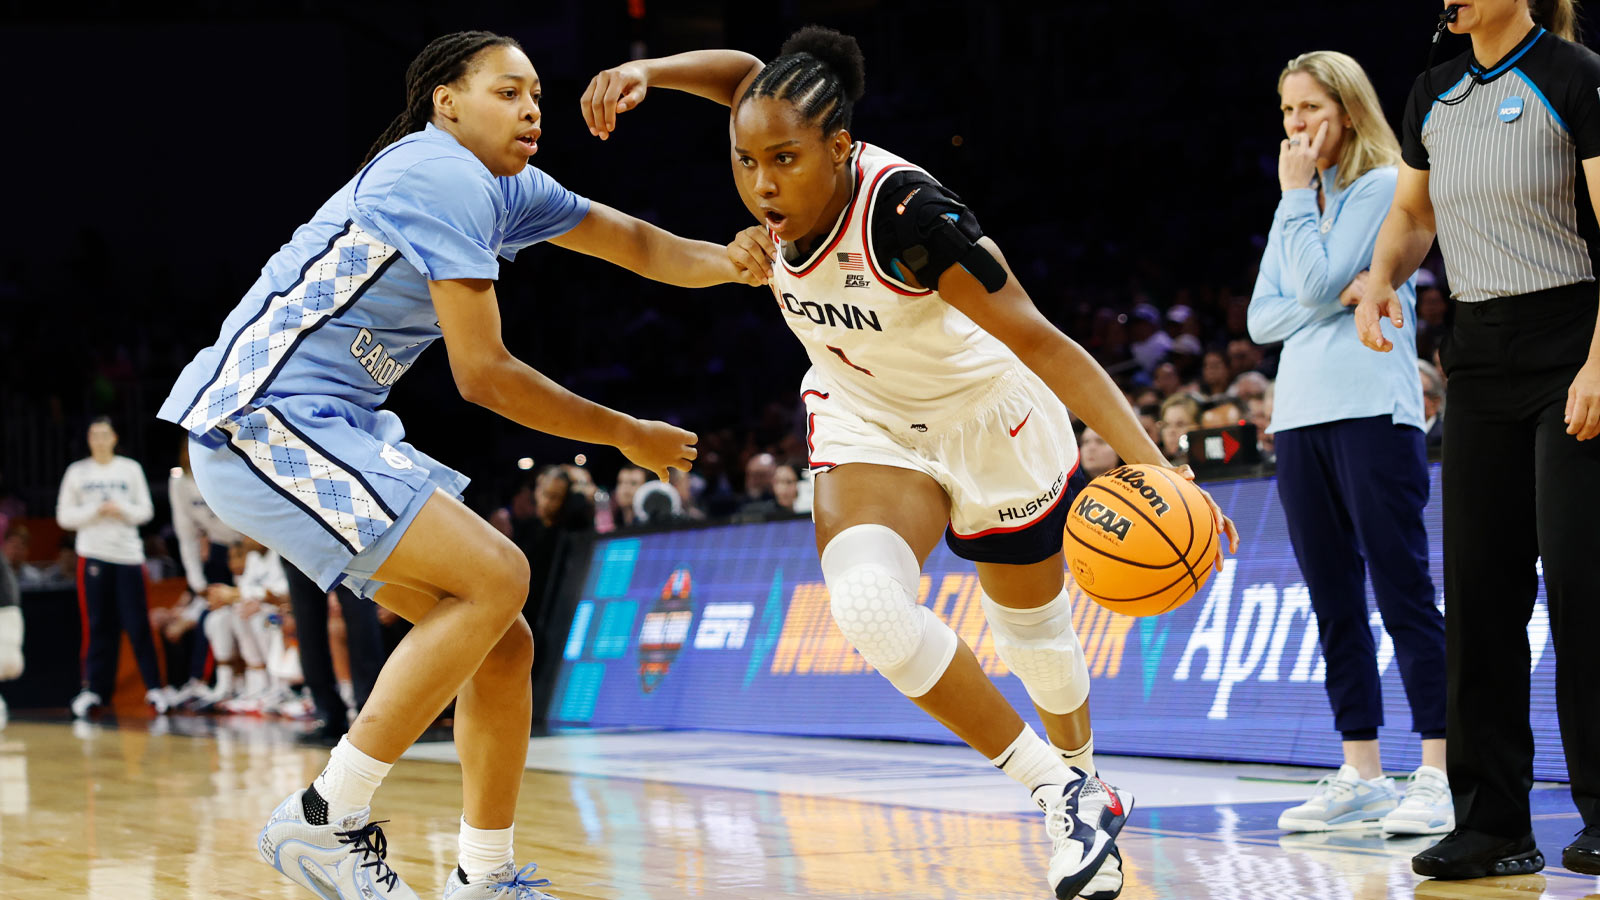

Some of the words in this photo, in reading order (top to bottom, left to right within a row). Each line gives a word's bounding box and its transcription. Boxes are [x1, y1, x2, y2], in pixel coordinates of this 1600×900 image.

[1500, 106, 1521, 115] NCAA
[845, 280, 871, 288] EAST
[826, 344, 876, 378] 1
[1098, 466, 1171, 517] Wilson
[1074, 494, 1132, 542] NCAA
[1173, 558, 1327, 720] Apri
